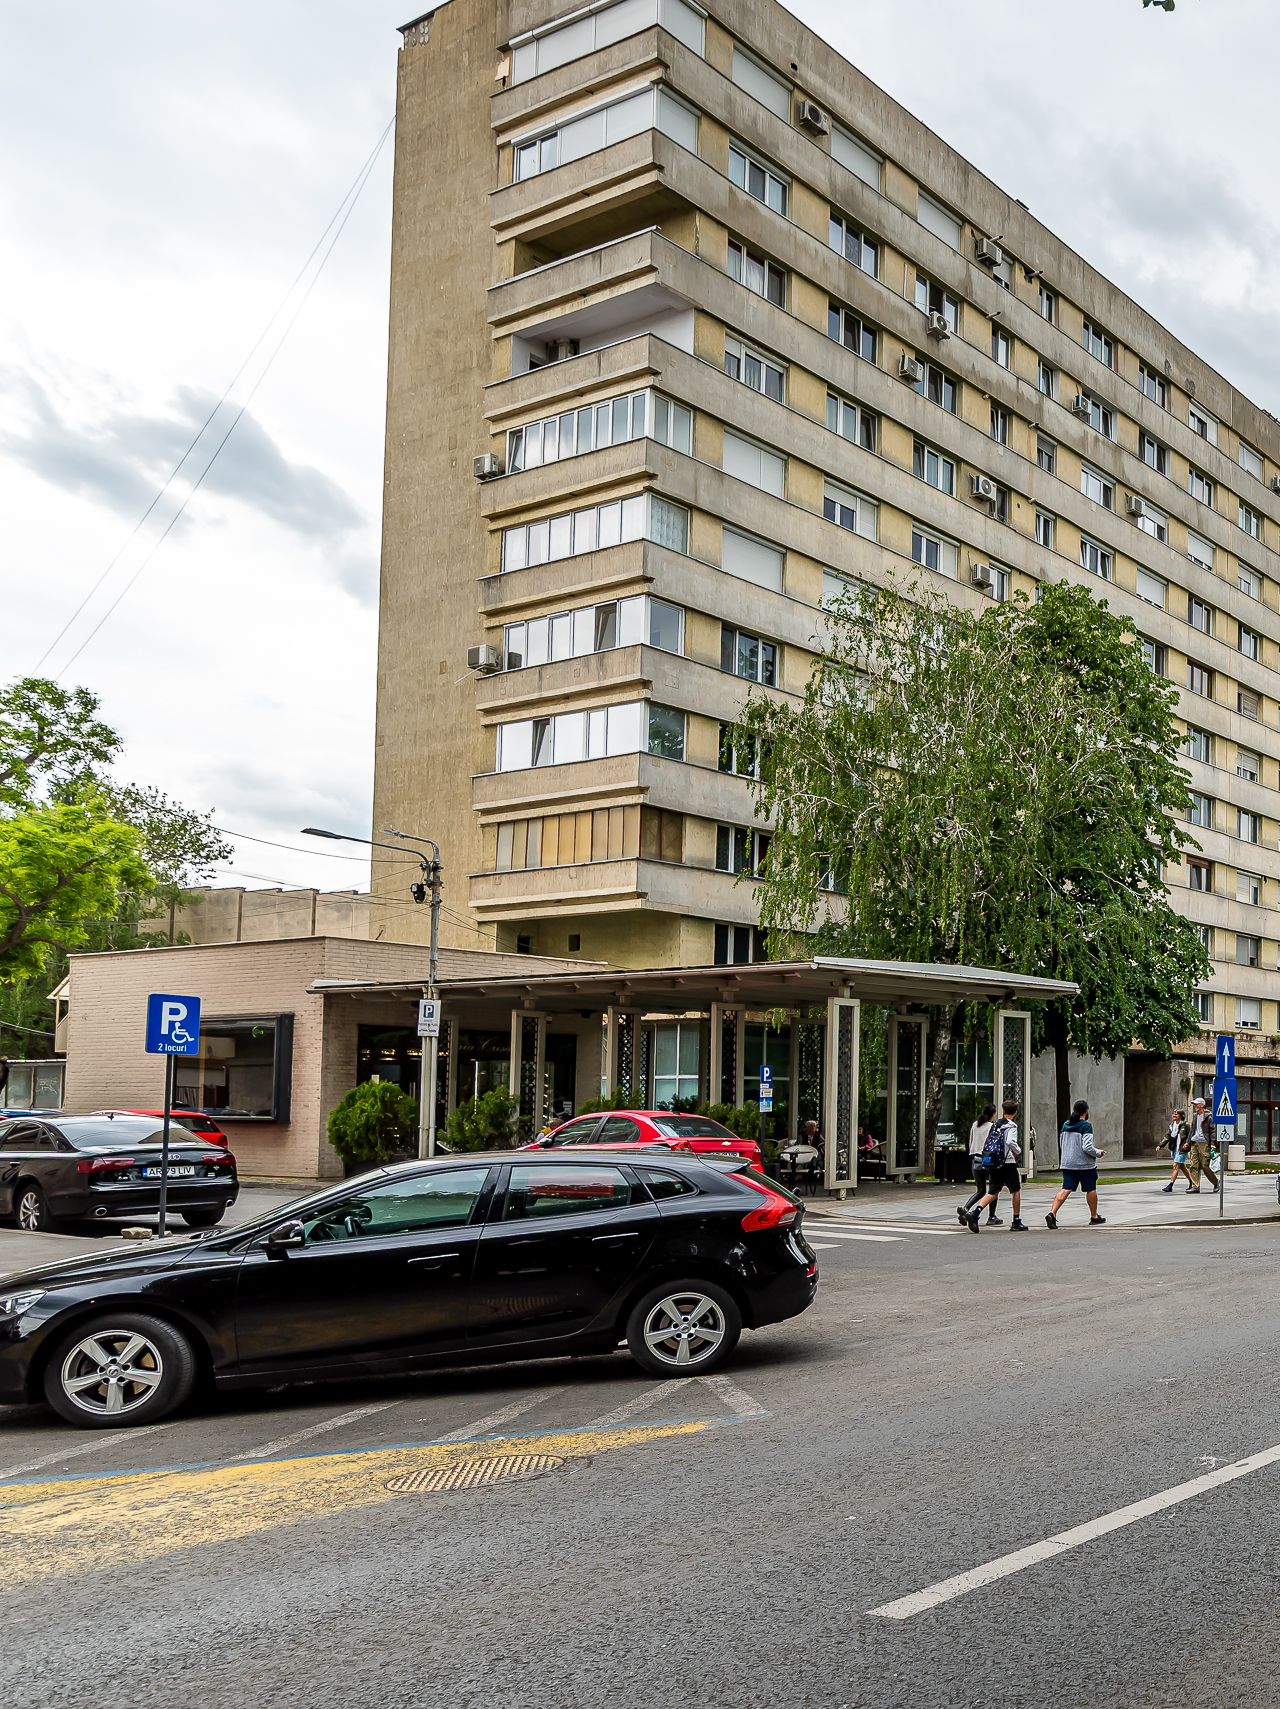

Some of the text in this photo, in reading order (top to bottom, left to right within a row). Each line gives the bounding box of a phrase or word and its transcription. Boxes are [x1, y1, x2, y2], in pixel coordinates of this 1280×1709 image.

[425, 1005, 433, 1017] P
[160, 1001, 188, 1035] P
[157, 1043, 187, 1052] 2 locuri
[763, 1067, 770, 1082] P
[148, 1168, 162, 1176] AR
[178, 1166, 192, 1174] LIV
